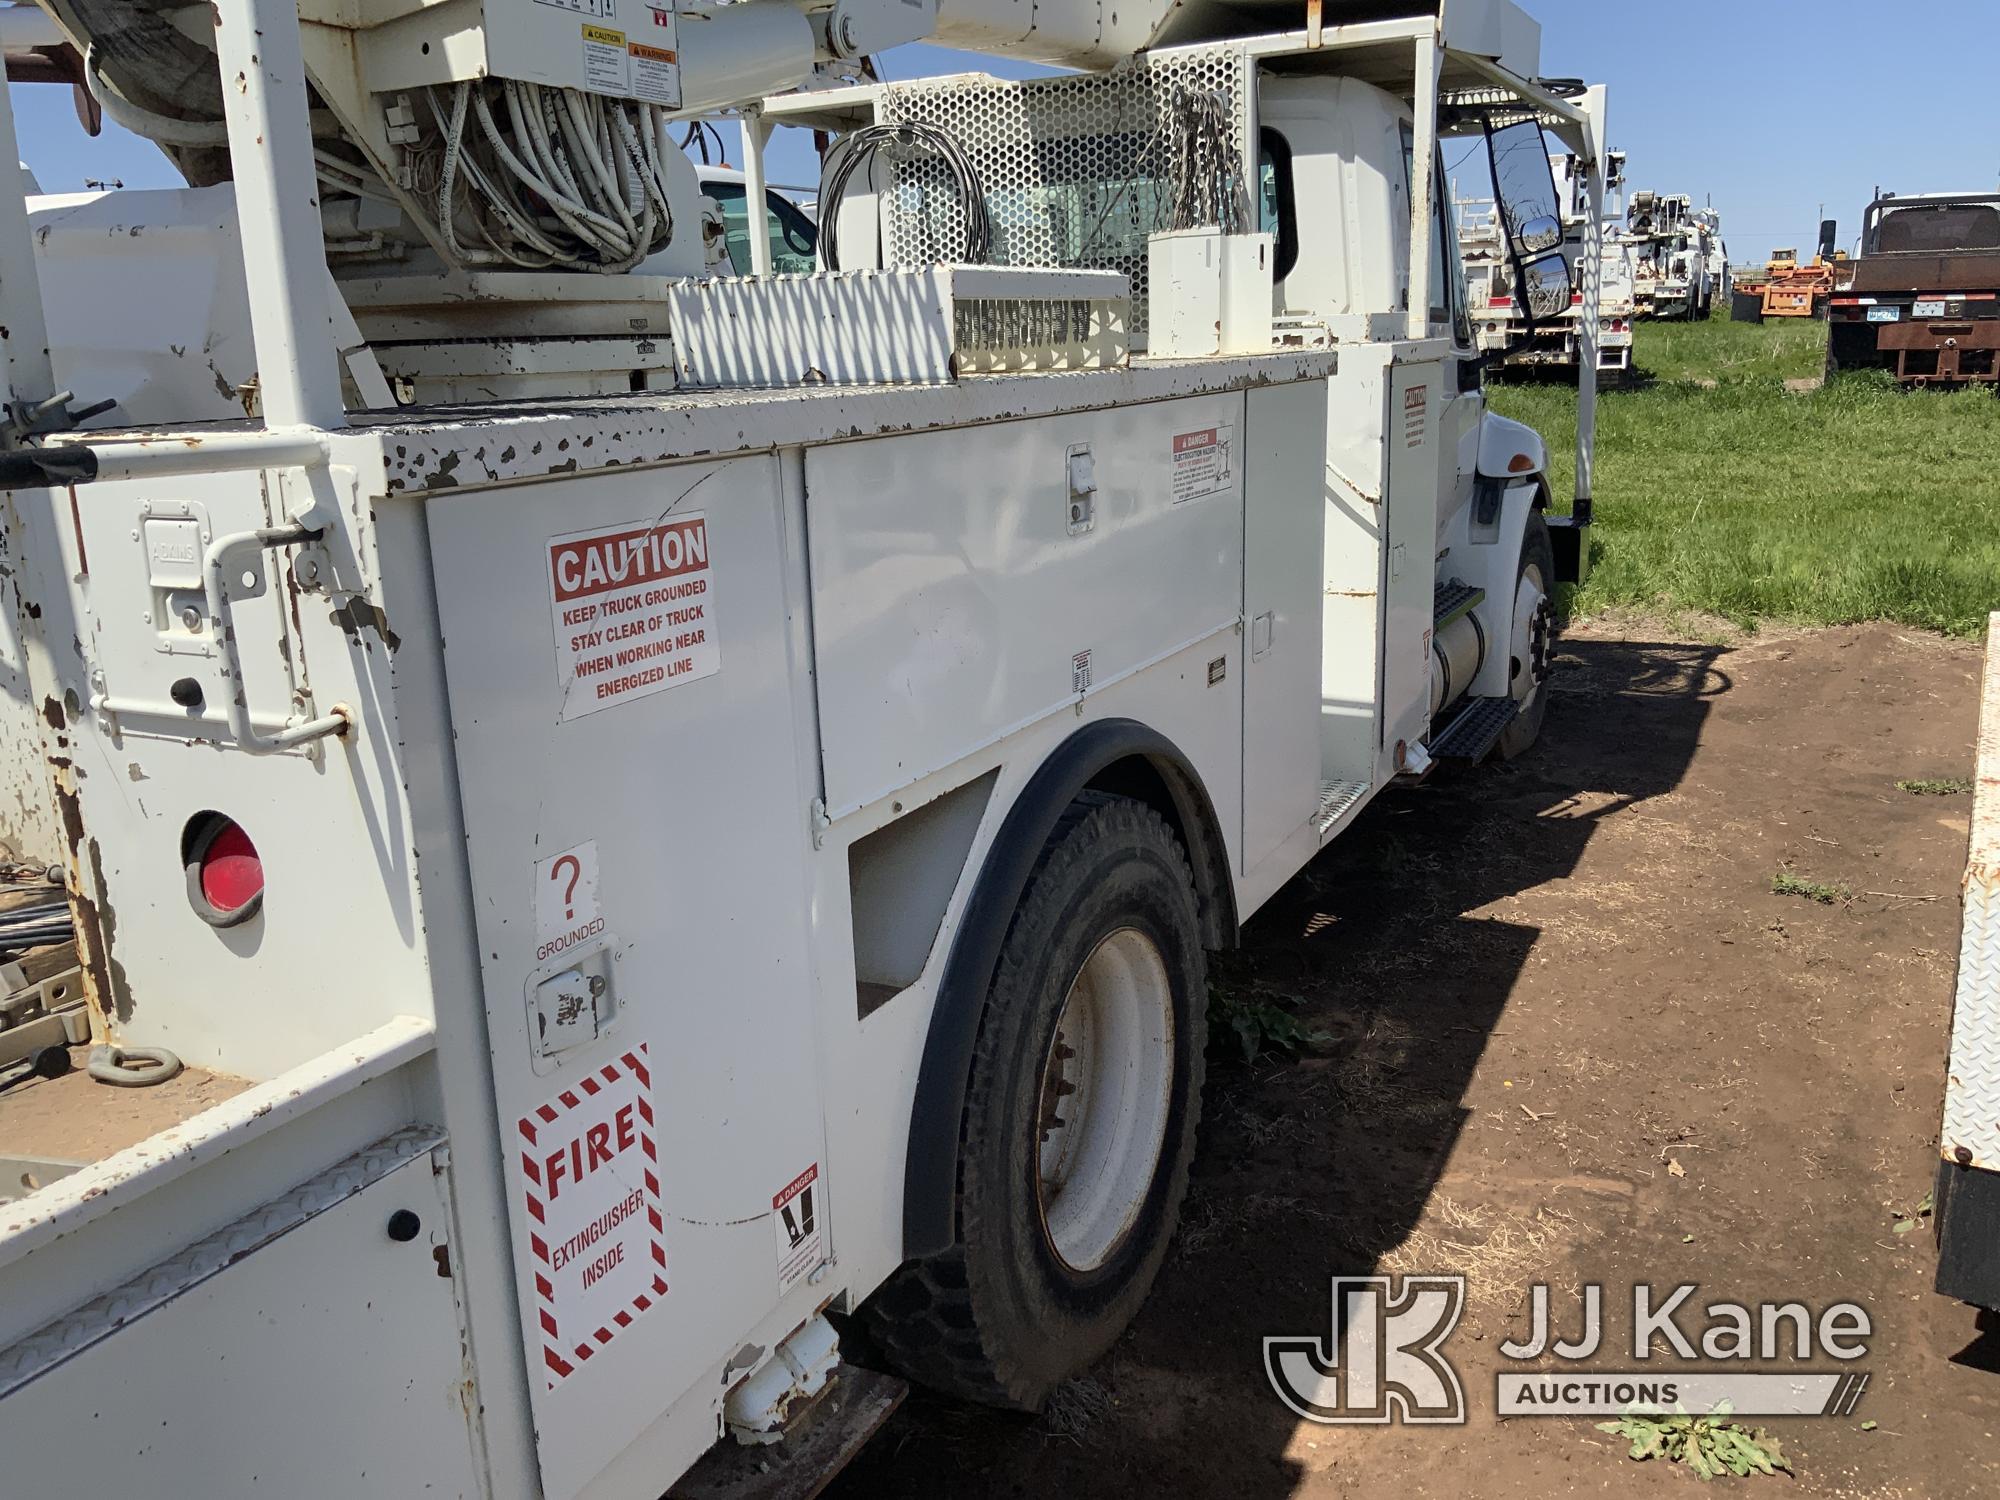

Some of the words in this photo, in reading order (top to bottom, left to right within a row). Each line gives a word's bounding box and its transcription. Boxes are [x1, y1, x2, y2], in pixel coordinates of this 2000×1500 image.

[594, 31, 621, 44] CAUTION
[640, 48, 672, 62] WARNING
[1406, 388, 1426, 406] CAUTION
[1187, 433, 1209, 447] DANGER
[557, 526, 706, 592] CAUTION
[563, 604, 597, 626] KEEP
[600, 594, 642, 617] TRUCK
[645, 579, 707, 606] GROUNDED
[571, 631, 603, 652] STAY
[606, 620, 645, 643] CLEAR
[648, 615, 663, 631] OF
[666, 605, 704, 627] TRUCK
[575, 654, 613, 678] WHEN
[616, 638, 673, 666] WORKING
[676, 629, 706, 650] NEAR
[597, 667, 664, 699] ENERGIZED
[667, 658, 693, 677] LINE
[551, 855, 580, 920] ?
[536, 917, 605, 961] GROUNDED
[545, 1102, 635, 1201] FIRE
[785, 1169, 814, 1200] DANGER
[552, 1188, 645, 1273] EXTINGUISHER
[582, 1241, 624, 1291] INSIDE
